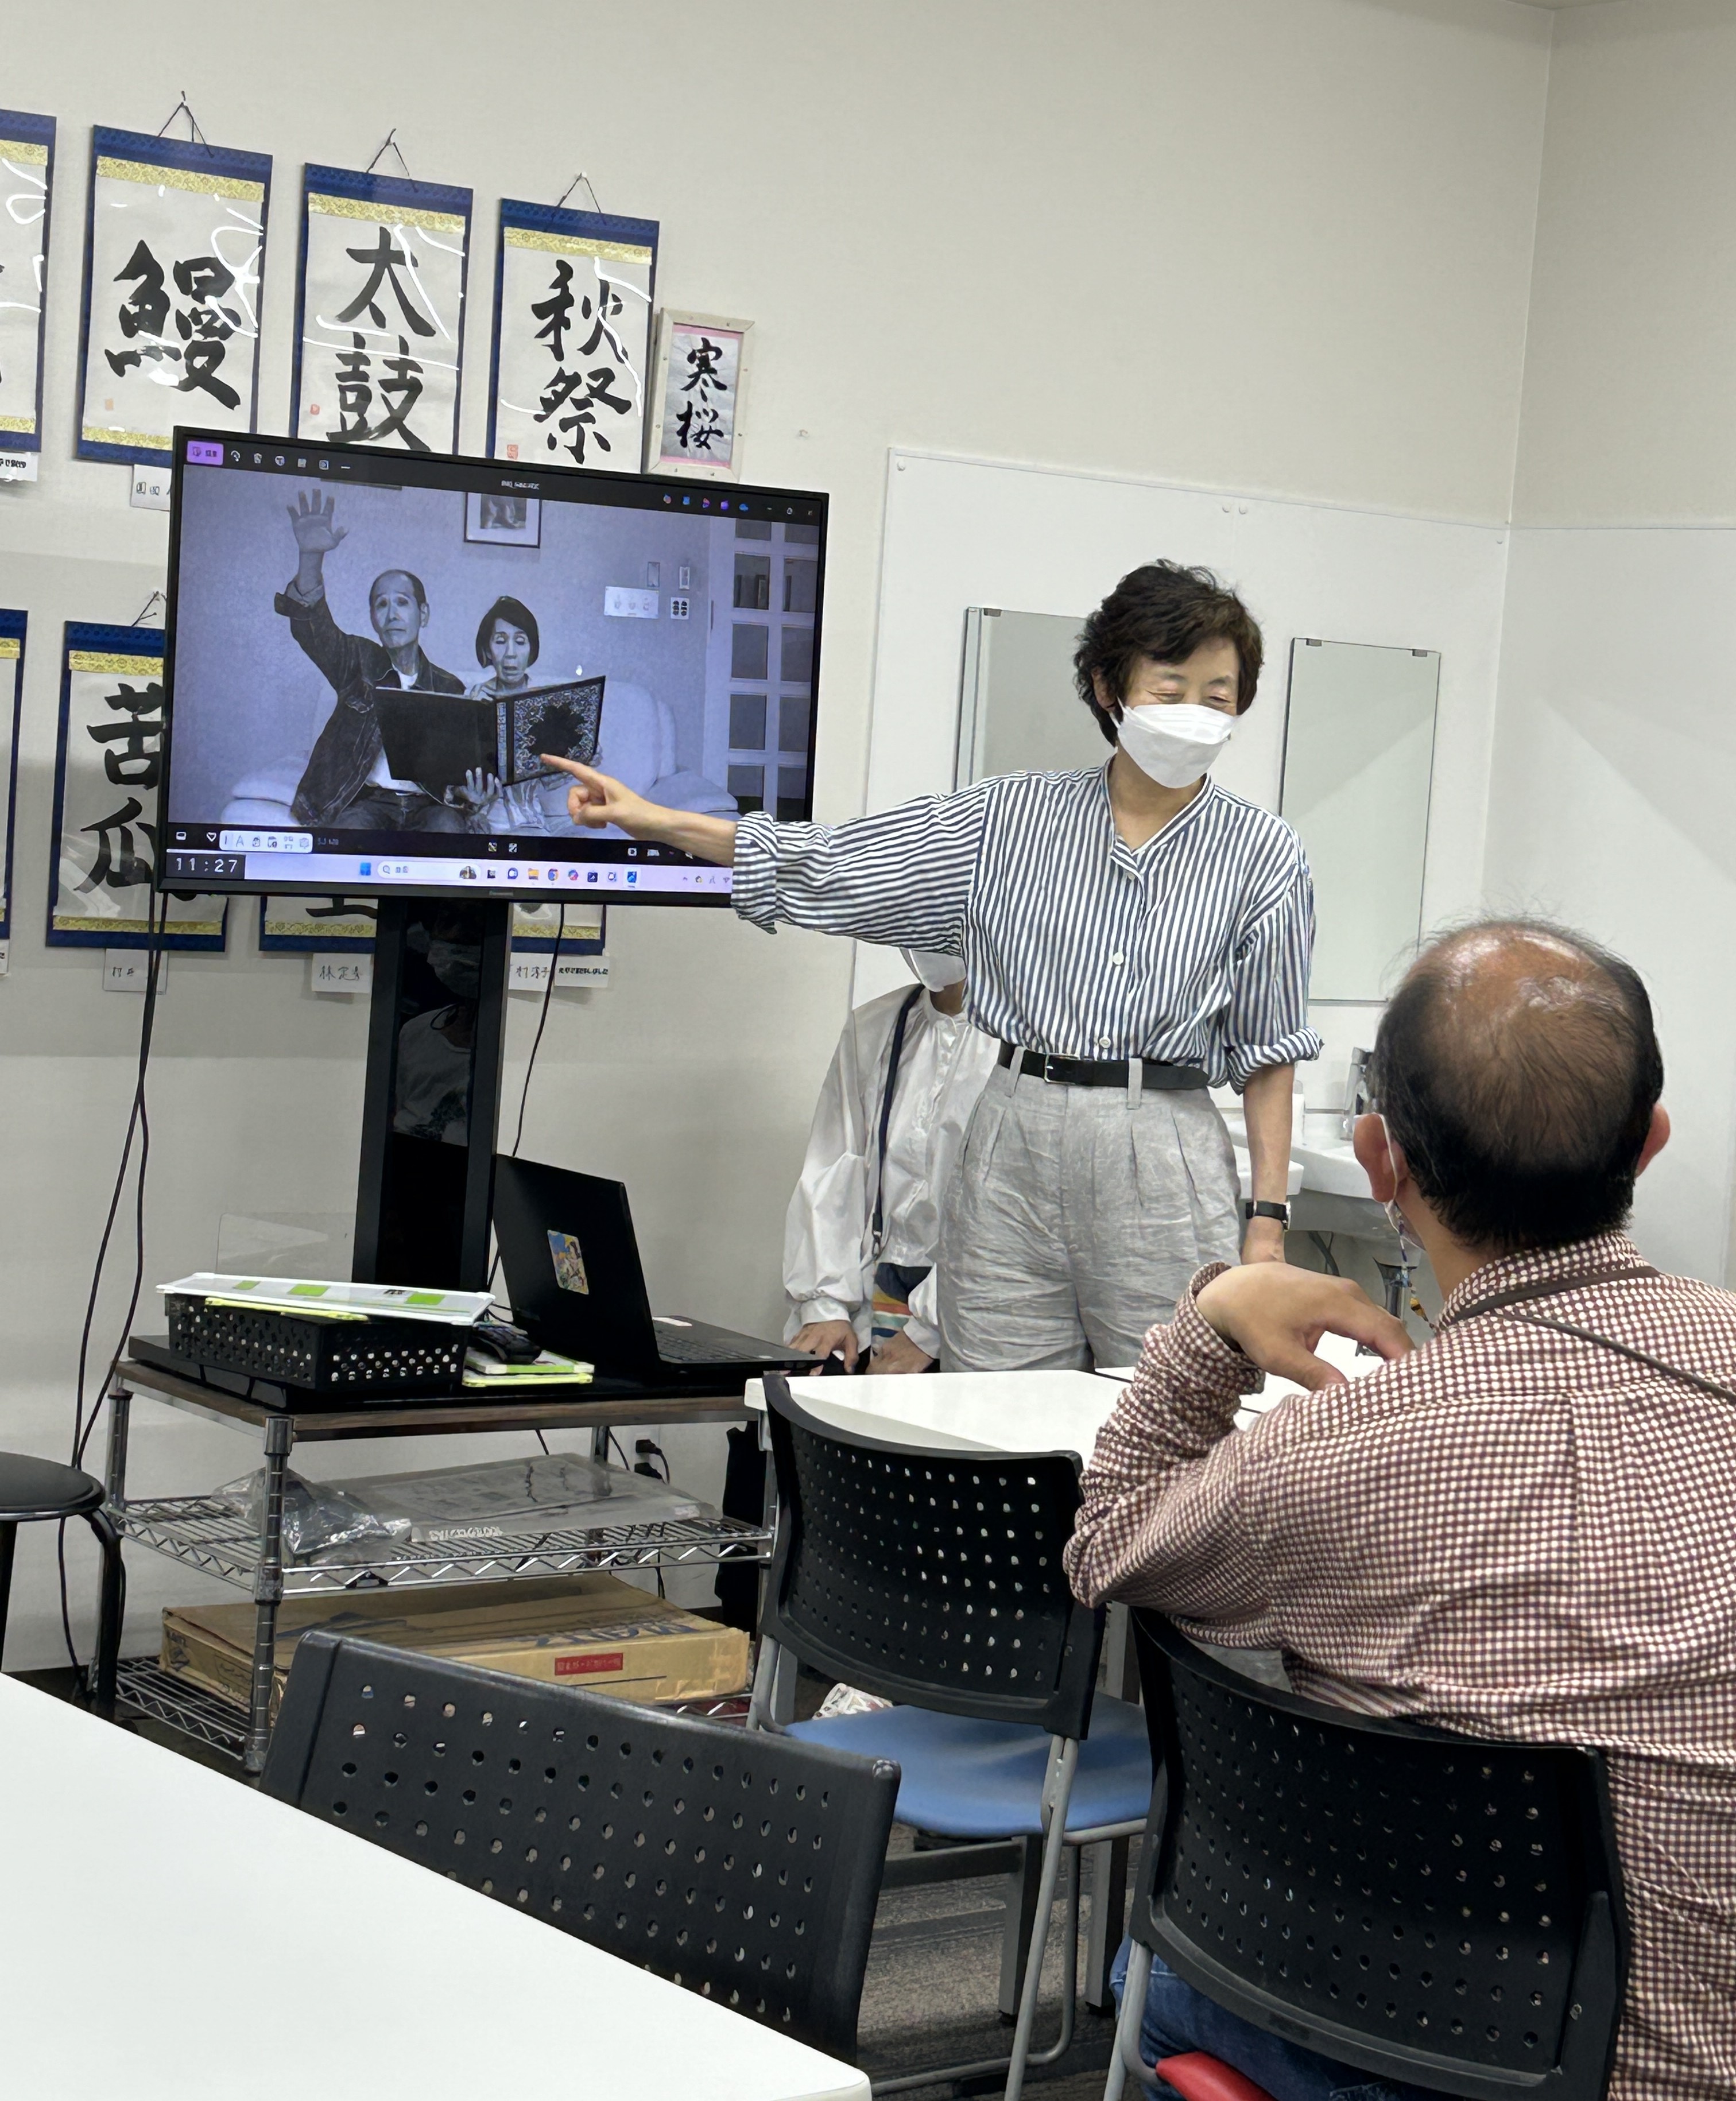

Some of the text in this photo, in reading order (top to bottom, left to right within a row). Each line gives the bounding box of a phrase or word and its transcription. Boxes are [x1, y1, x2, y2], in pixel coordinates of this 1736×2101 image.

[104, 240, 242, 410] 鰻
[326, 226, 437, 452] 太鼓
[531, 259, 631, 464] 秋祭
[676, 338, 727, 449] 寒桜
[176, 858, 239, 873] 11:27
